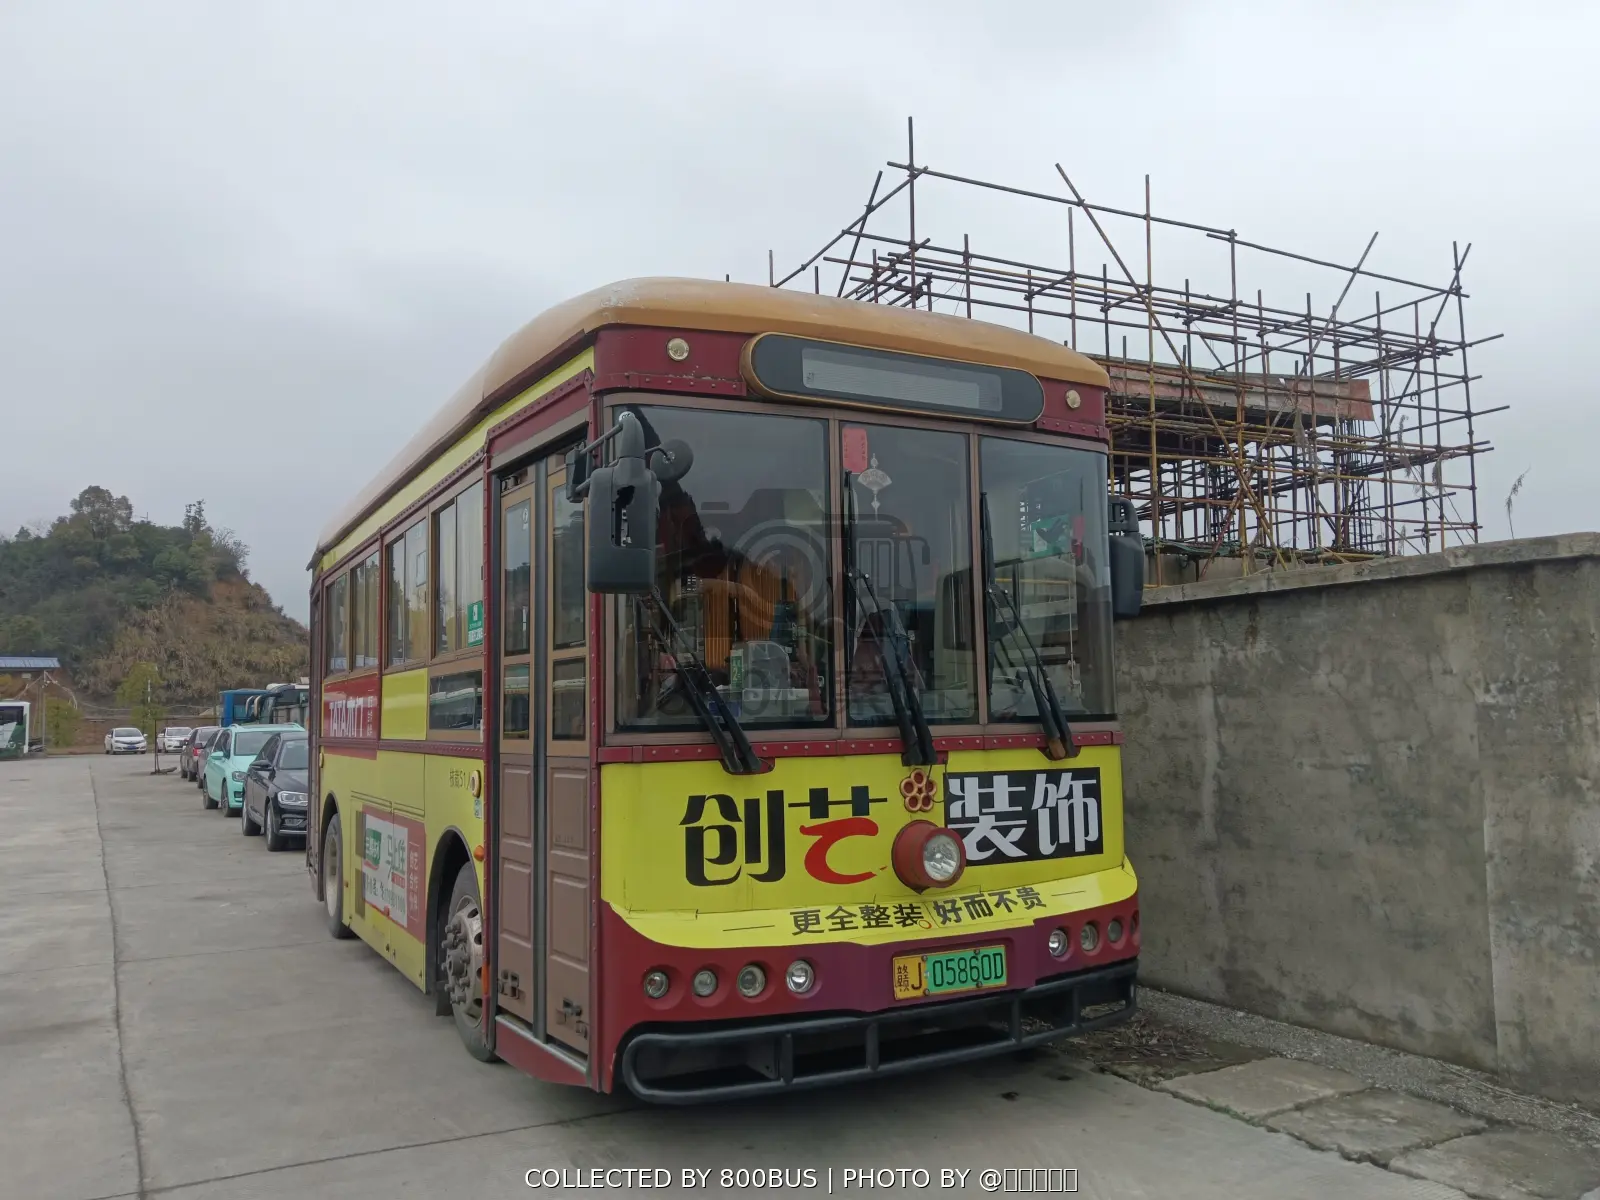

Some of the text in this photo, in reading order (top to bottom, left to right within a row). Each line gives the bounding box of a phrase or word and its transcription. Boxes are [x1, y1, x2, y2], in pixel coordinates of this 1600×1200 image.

[679, 771, 1099, 887] 创艺 装饰
[790, 886, 1047, 936] 更全整装 好而不贵
